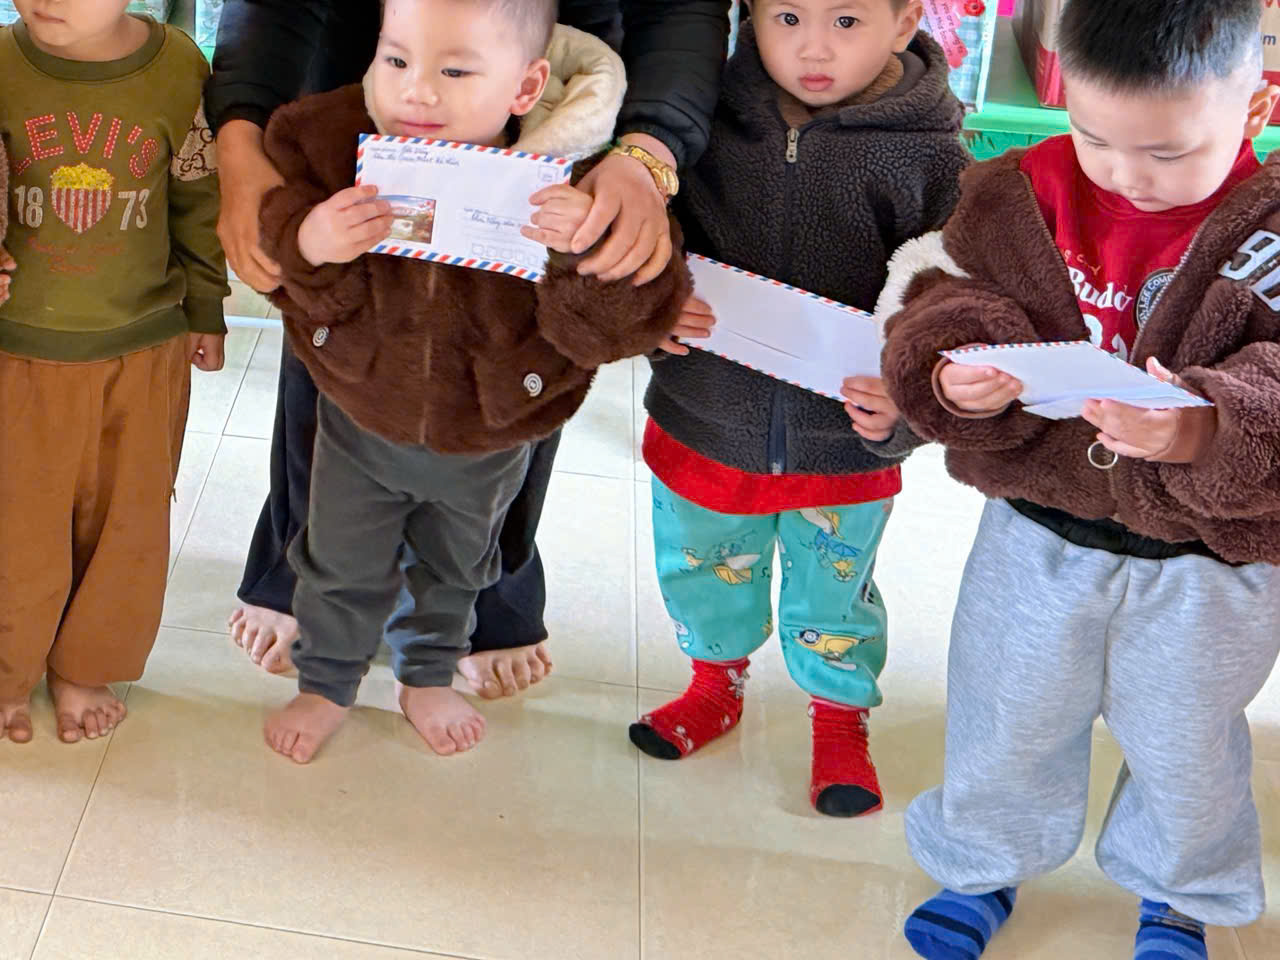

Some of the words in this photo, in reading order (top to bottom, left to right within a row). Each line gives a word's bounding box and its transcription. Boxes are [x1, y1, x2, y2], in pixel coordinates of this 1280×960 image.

[16, 111, 159, 179] EVI'S
[14, 184, 44, 228] 18
[118, 189, 151, 230] 73
